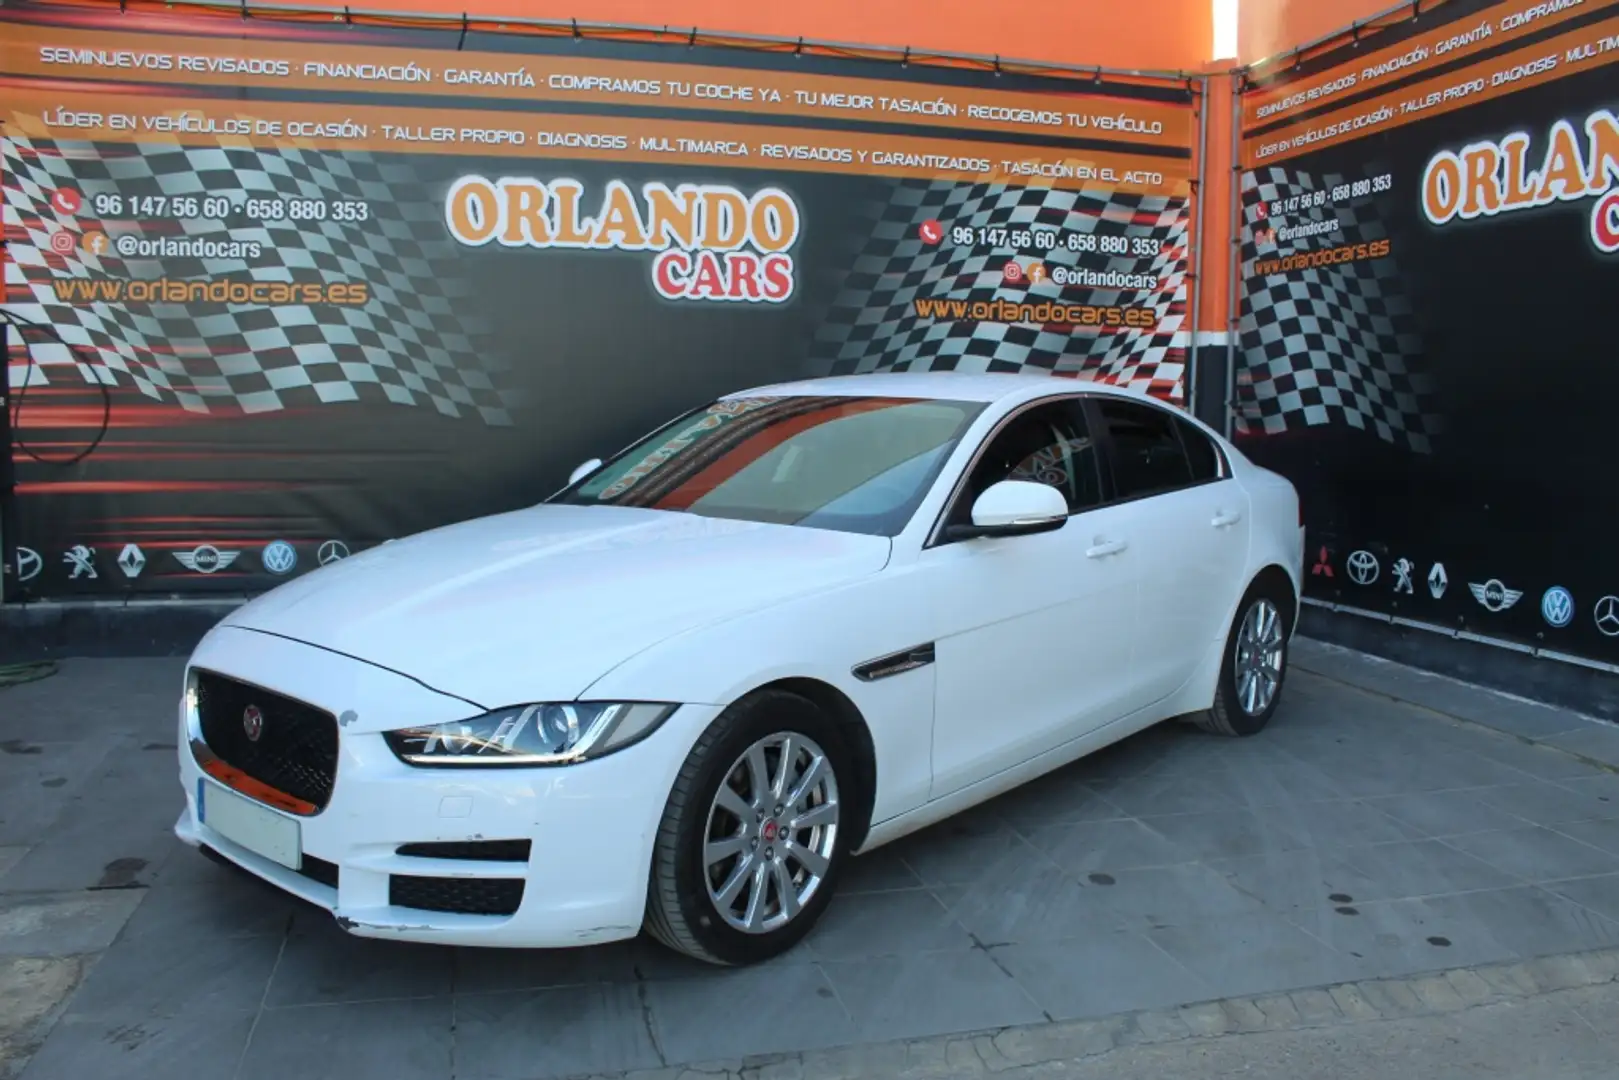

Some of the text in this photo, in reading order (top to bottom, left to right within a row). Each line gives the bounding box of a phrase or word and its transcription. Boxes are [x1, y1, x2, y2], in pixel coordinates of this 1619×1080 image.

[1256, 92, 1306, 119] SEMINUEVOS
[1307, 73, 1356, 101] REVISADOS
[1435, 21, 1493, 55] GARANTÍA
[40, 47, 1162, 135] SEMINUEVOS REVISADOS FINANCIACIÓN GARANTÍA COMPRAMOS TU COCHE YA TU MEJOR TASACIÓN RECOGEMOS TU VEHÍCULO
[1255, 144, 1279, 160] LÍDER
[1292, 125, 1338, 148] VEHÍCULOS
[1339, 120, 1352, 134] DE
[1353, 104, 1394, 130] OCASIÓN
[1400, 91, 1441, 114] TALLER
[1443, 78, 1485, 102] PROPIO
[1492, 54, 1558, 87] DIAGNOSIS
[44, 105, 1162, 186] LÍDER EN VEHÍCULOS DE OCASIÓN TALLER PROPIO DIAGNOSIS MULTIMARCA REVISADOS Y GARANTIZADOS TASACIÓN EN EL ACTO
[96, 194, 368, 222] 96 147 56 60 658 880 353
[1271, 174, 1392, 216] 96 147 56 60 658 880 353
[446, 175, 800, 253] ORLANDO
[1278, 218, 1339, 242] @orlandocars
[117, 235, 261, 259] @orlandocars
[953, 226, 1160, 256] 96 147 56 60 658 880 353
[1255, 239, 1390, 275] www.orlandocars.es
[53, 277, 368, 305] www.orlandocars.es
[652, 251, 794, 302] CARS
[1051, 266, 1157, 289] @orlandocars
[915, 299, 1156, 327] www.orlandocars.es
